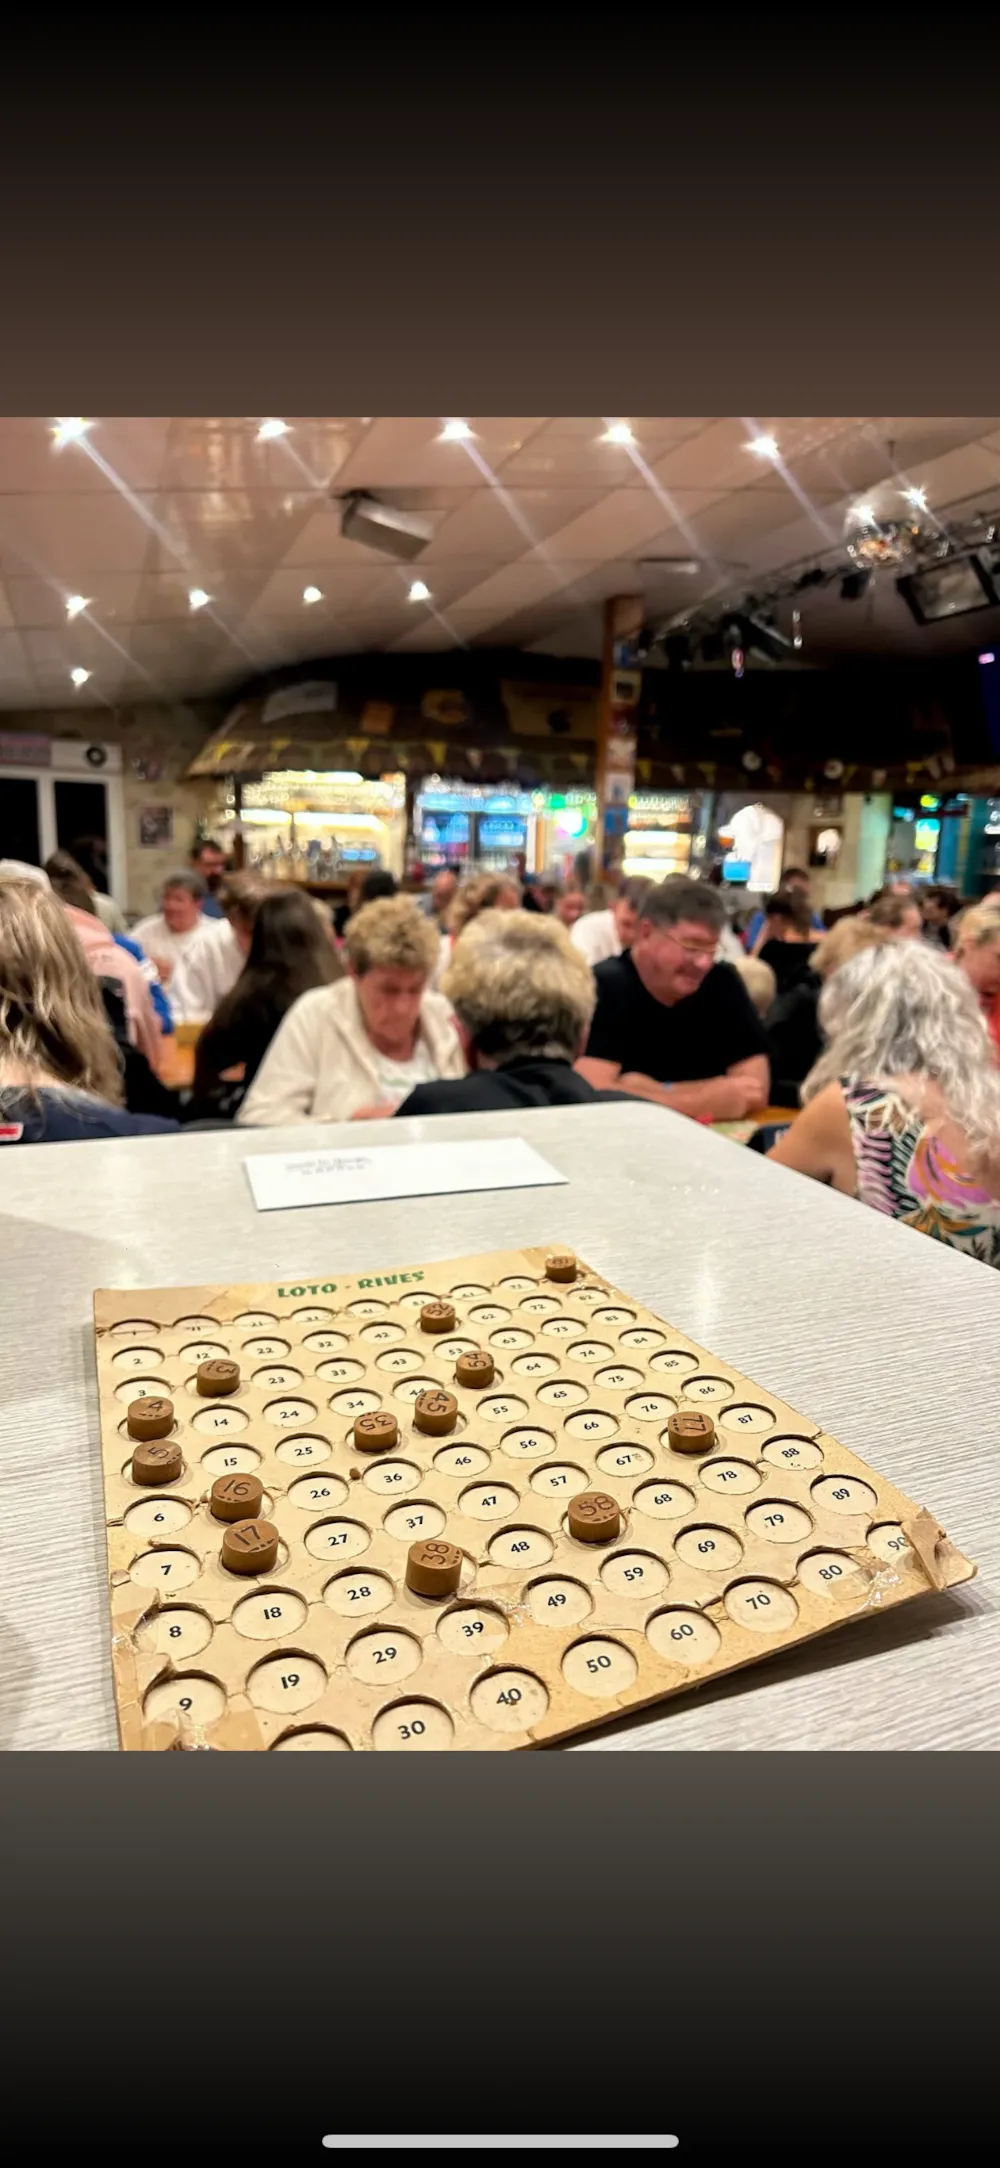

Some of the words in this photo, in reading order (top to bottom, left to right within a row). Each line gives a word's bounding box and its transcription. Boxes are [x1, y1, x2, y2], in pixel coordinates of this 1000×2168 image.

[277, 1283, 338, 1298] LOTO
[357, 1271, 425, 1290] RIVES
[427, 1303, 450, 1317] 52
[529, 1303, 546, 1311] 72
[481, 1313, 497, 1321] 62
[374, 1331, 391, 1339] 42
[553, 1325, 569, 1333] 73
[317, 1340, 334, 1348] 32
[502, 1336, 517, 1344] 63
[632, 1335, 648, 1344] 84
[195, 1352, 211, 1360] 12
[256, 1347, 275, 1355] 22
[579, 1349, 596, 1357] 74
[391, 1358, 408, 1366] 43
[463, 1352, 487, 1368] 54
[663, 1359, 679, 1369] 85
[525, 1362, 541, 1371] 64
[331, 1369, 347, 1377] 33
[607, 1374, 624, 1383] 75
[268, 1376, 286, 1385] 23
[138, 1389, 147, 1397] 3
[553, 1391, 568, 1399] 65
[699, 1385, 716, 1395] 86
[148, 1400, 164, 1412] 4
[346, 1400, 365, 1408] 34
[427, 1392, 450, 1413] 45
[641, 1403, 659, 1413] 76
[280, 1410, 300, 1419] 24
[492, 1405, 509, 1414] 55
[213, 1418, 229, 1427] 14
[359, 1414, 393, 1431] 35
[583, 1421, 600, 1430] 66
[680, 1414, 706, 1433] 77
[737, 1414, 754, 1425] 87
[519, 1439, 537, 1448] 56
[147, 1447, 169, 1459] 5
[294, 1447, 313, 1456] 25
[781, 1447, 801, 1459] 88
[223, 1458, 238, 1466] 15
[455, 1455, 472, 1465] 46
[615, 1454, 633, 1466] 67
[383, 1472, 402, 1483] 36
[550, 1475, 567, 1487] 57
[717, 1470, 738, 1482] 78
[222, 1479, 250, 1497] 16
[310, 1487, 331, 1500] 26
[831, 1487, 852, 1500] 89
[481, 1495, 498, 1507] 47
[653, 1492, 673, 1506] 68
[579, 1495, 615, 1516] 58
[153, 1512, 165, 1523] 6
[406, 1515, 424, 1529] 37
[764, 1513, 785, 1527] 79
[233, 1523, 262, 1547] 17
[327, 1533, 348, 1547] 27
[510, 1541, 530, 1553] 48
[697, 1539, 716, 1554] 69
[887, 1536, 909, 1552] 90
[420, 1542, 450, 1566] 38
[160, 1564, 172, 1576] 7
[623, 1566, 644, 1582] 59
[818, 1564, 843, 1581] 80
[347, 1586, 371, 1601] 28
[547, 1593, 567, 1608] 49
[745, 1593, 772, 1611] 70
[263, 1606, 282, 1620] 18
[168, 1625, 182, 1638] 8
[462, 1621, 484, 1638] 39
[670, 1623, 694, 1641] 60
[372, 1647, 398, 1664] 29
[586, 1655, 612, 1673] 50
[280, 1673, 300, 1690] 19
[496, 1688, 522, 1706] 40
[178, 1697, 193, 1711] 9
[397, 1720, 426, 1740] 30
